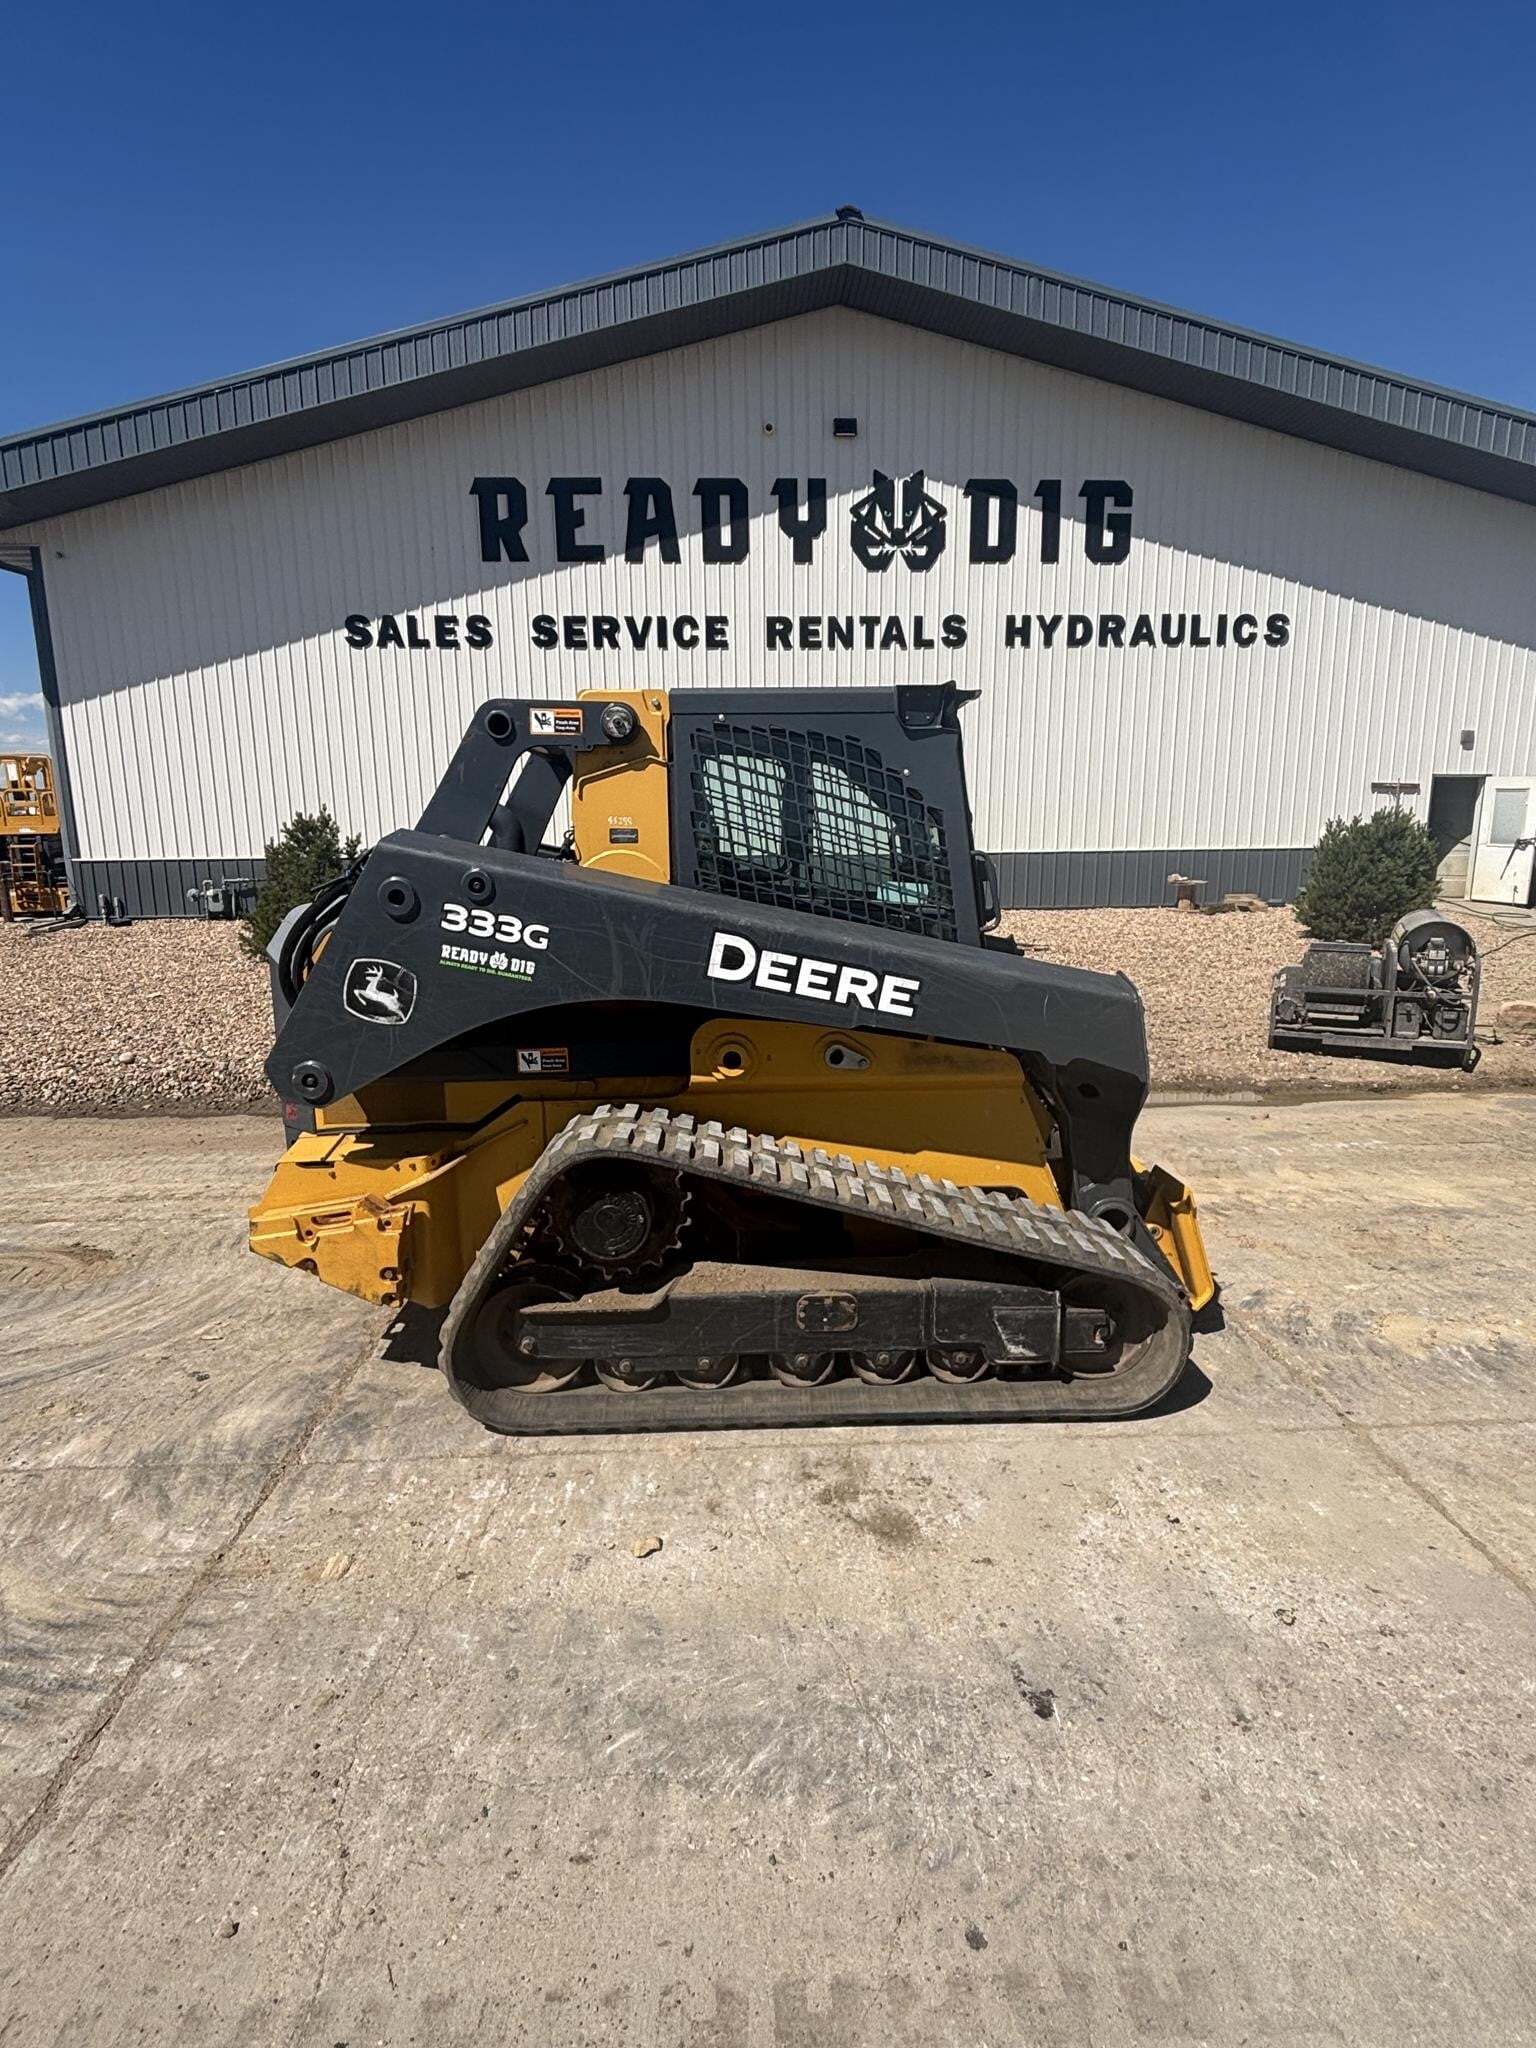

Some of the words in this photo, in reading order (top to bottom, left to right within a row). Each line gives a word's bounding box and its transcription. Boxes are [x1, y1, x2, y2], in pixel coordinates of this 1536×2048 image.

[469, 477, 826, 564] READY
[963, 478, 1133, 565] DIG
[345, 614, 493, 650] SALES
[532, 615, 729, 651] SERVICE
[766, 615, 967, 650] RENTALS
[1005, 613, 1291, 649] HYDRAULICS
[441, 903, 550, 950] 333G
[441, 944, 489, 966] READY
[510, 957, 536, 975] DIG
[707, 932, 921, 1017] DEERE
